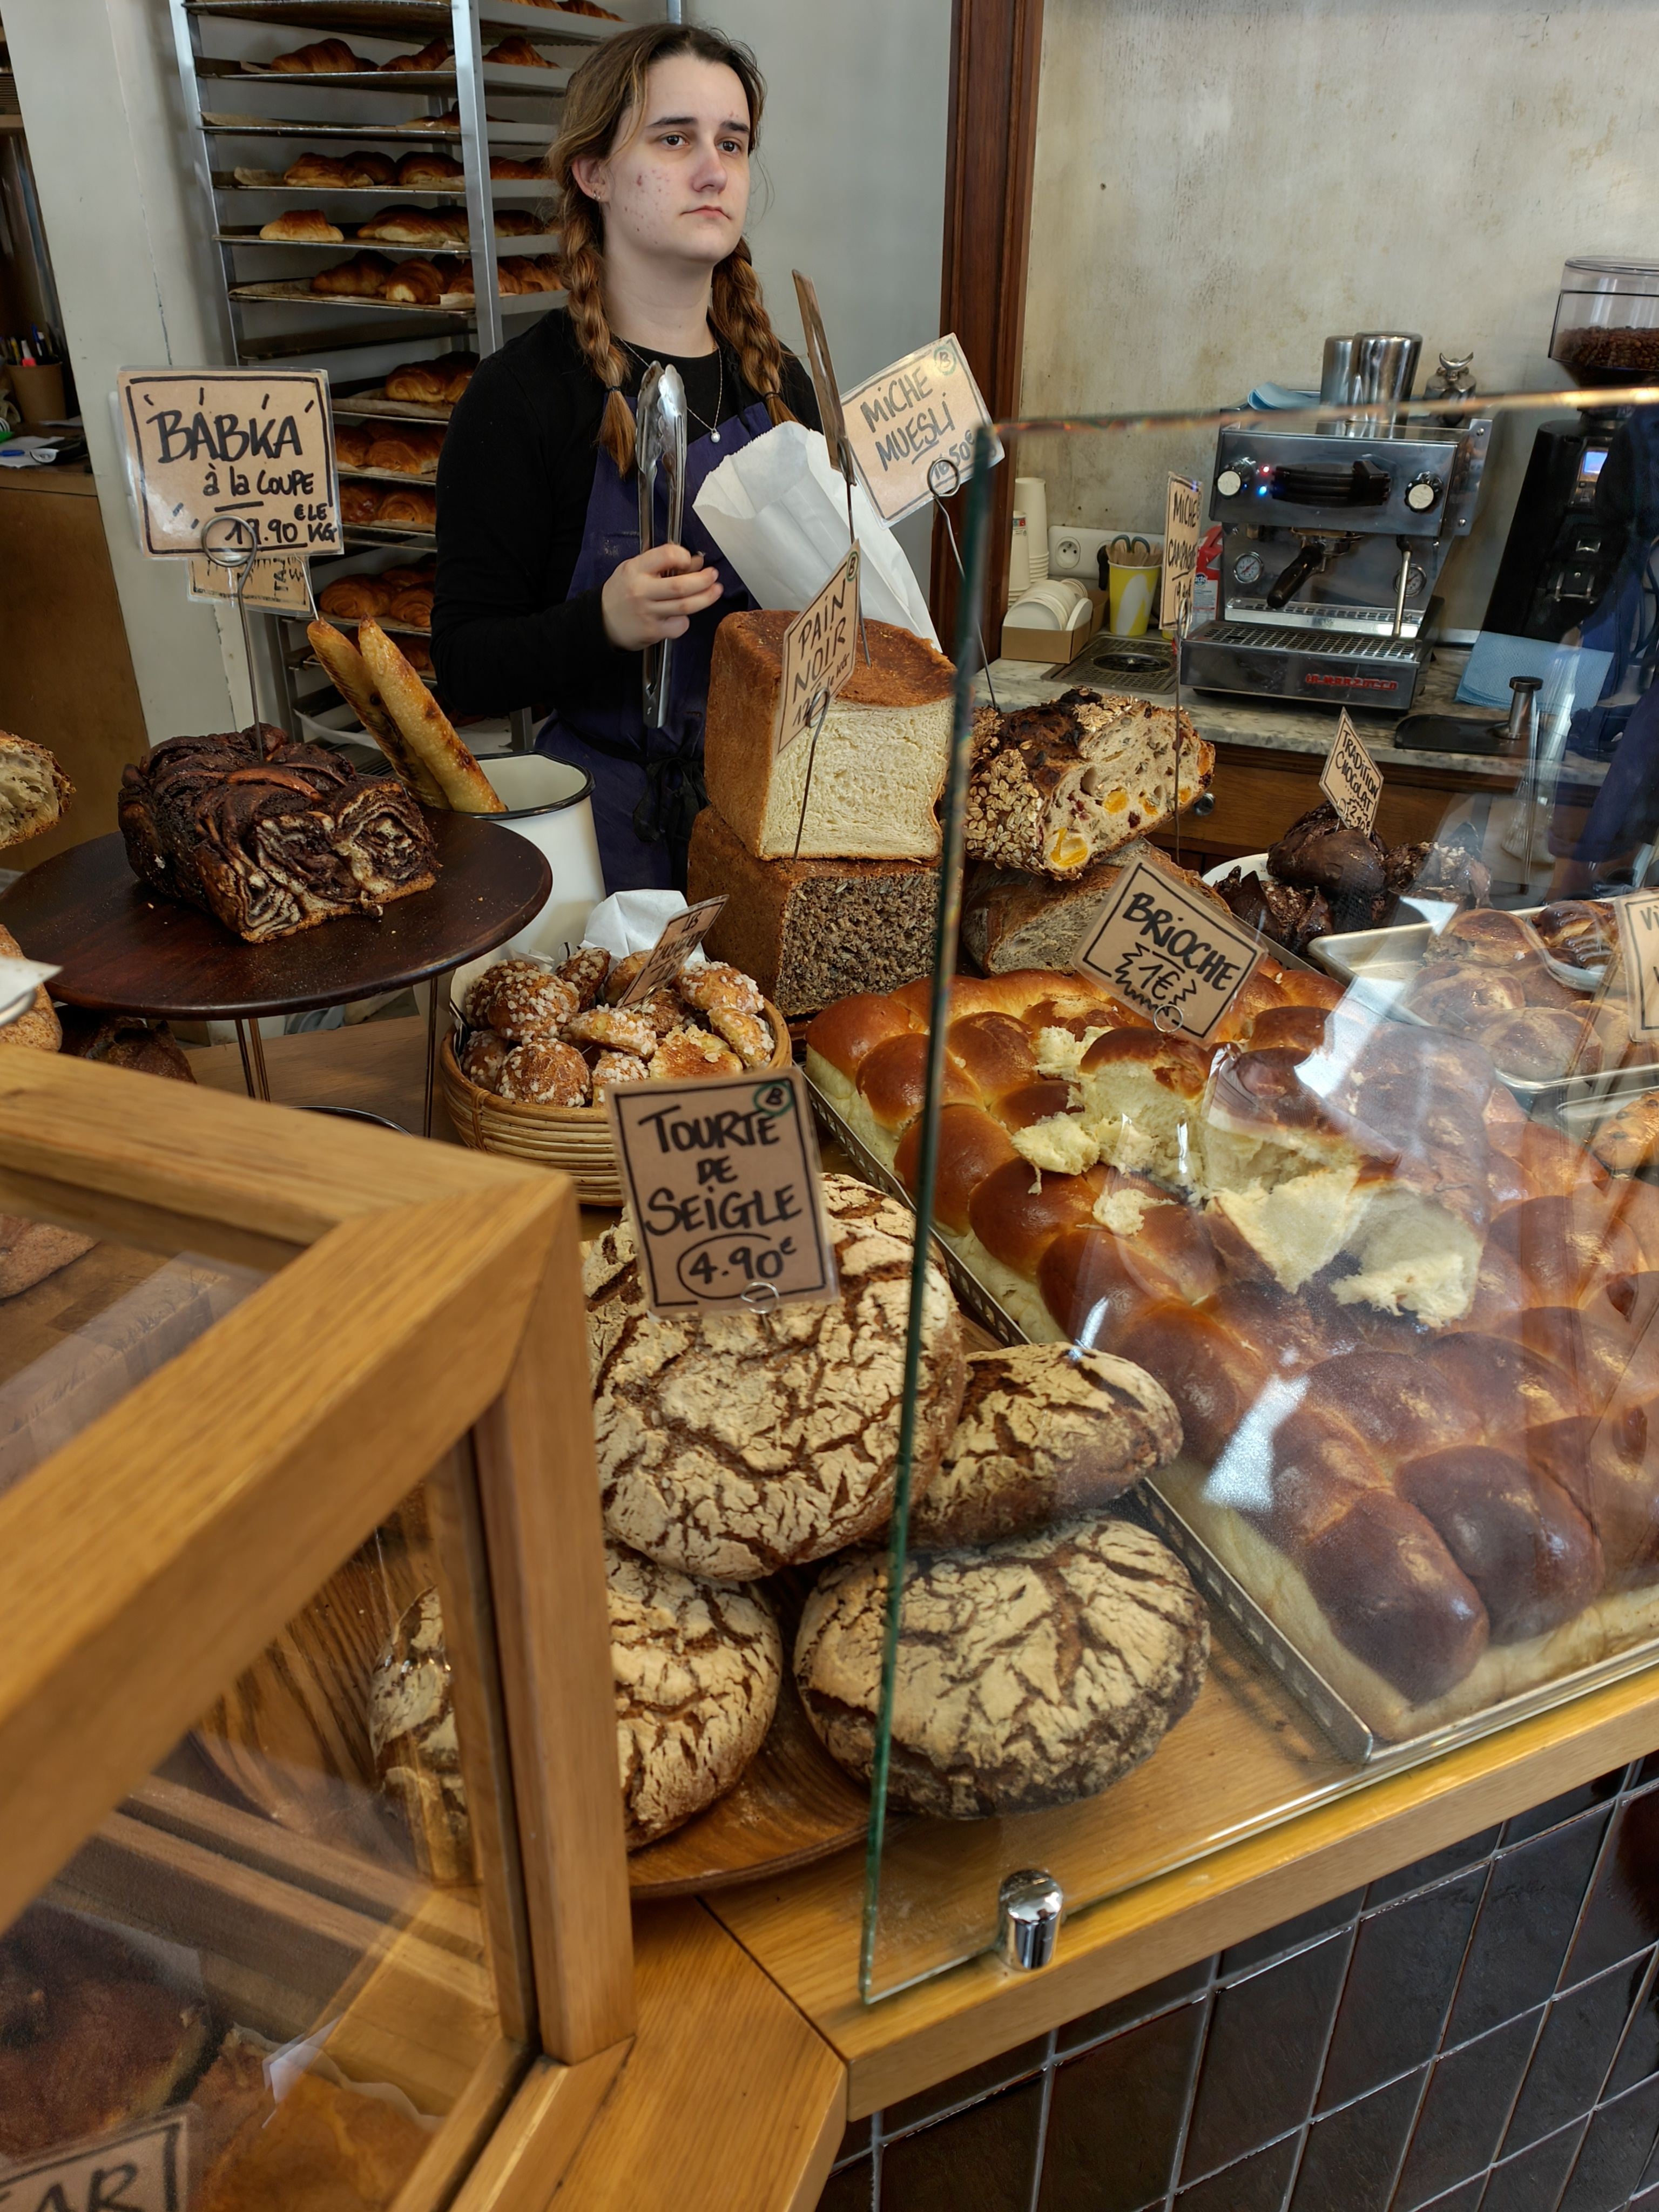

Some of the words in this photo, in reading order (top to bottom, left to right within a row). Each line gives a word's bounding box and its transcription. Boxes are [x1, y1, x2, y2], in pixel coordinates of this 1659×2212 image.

[861, 367, 933, 433] MICHE
[146, 409, 304, 463] BABKA
[875, 393, 955, 471] MUESLI
[203, 463, 220, 496] à
[229, 466, 251, 496] la
[257, 469, 314, 496] COUPE
[307, 522, 338, 543] KG
[1173, 488, 1197, 528] MICHE
[798, 578, 846, 660] PAIN
[793, 617, 846, 704] NOIR
[1336, 751, 1373, 812] CHOCOLAT
[1343, 730, 1380, 799] TRADITION
[1122, 893, 1240, 990] BRIOCHE
[766, 1088, 783, 1105] B
[638, 1105, 780, 1154] TOURTE
[697, 1156, 738, 1185] DE
[645, 1184, 802, 1236] SEIGLE
